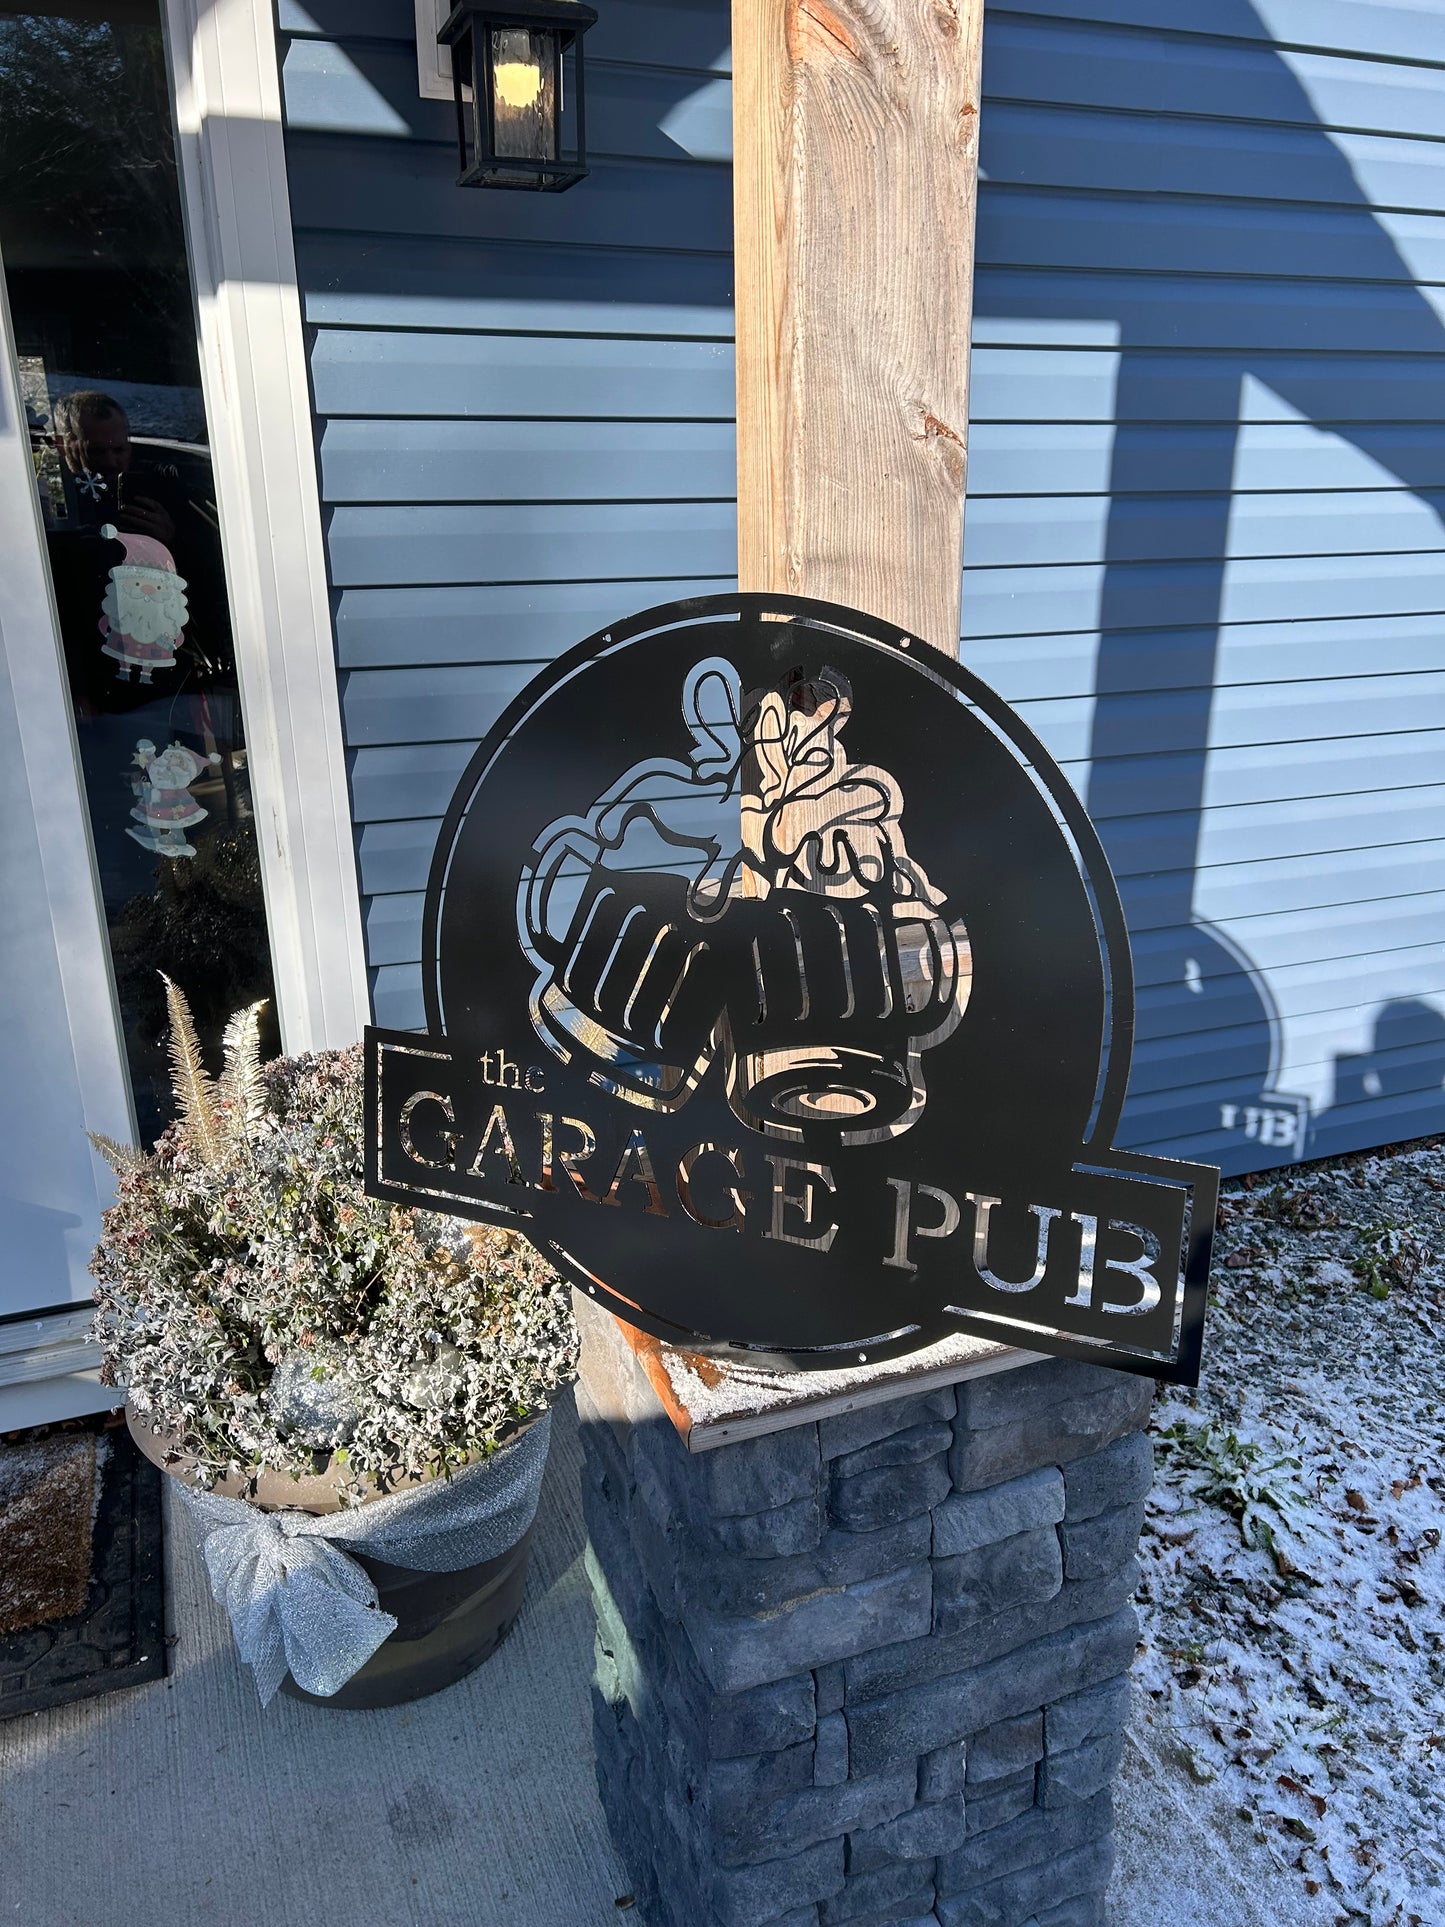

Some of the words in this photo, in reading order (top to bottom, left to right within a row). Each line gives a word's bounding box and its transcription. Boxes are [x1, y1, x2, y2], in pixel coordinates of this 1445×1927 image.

[478, 1048, 546, 1093] the
[399, 1090, 839, 1253] GARAGE
[882, 1176, 1162, 1316] PUB
